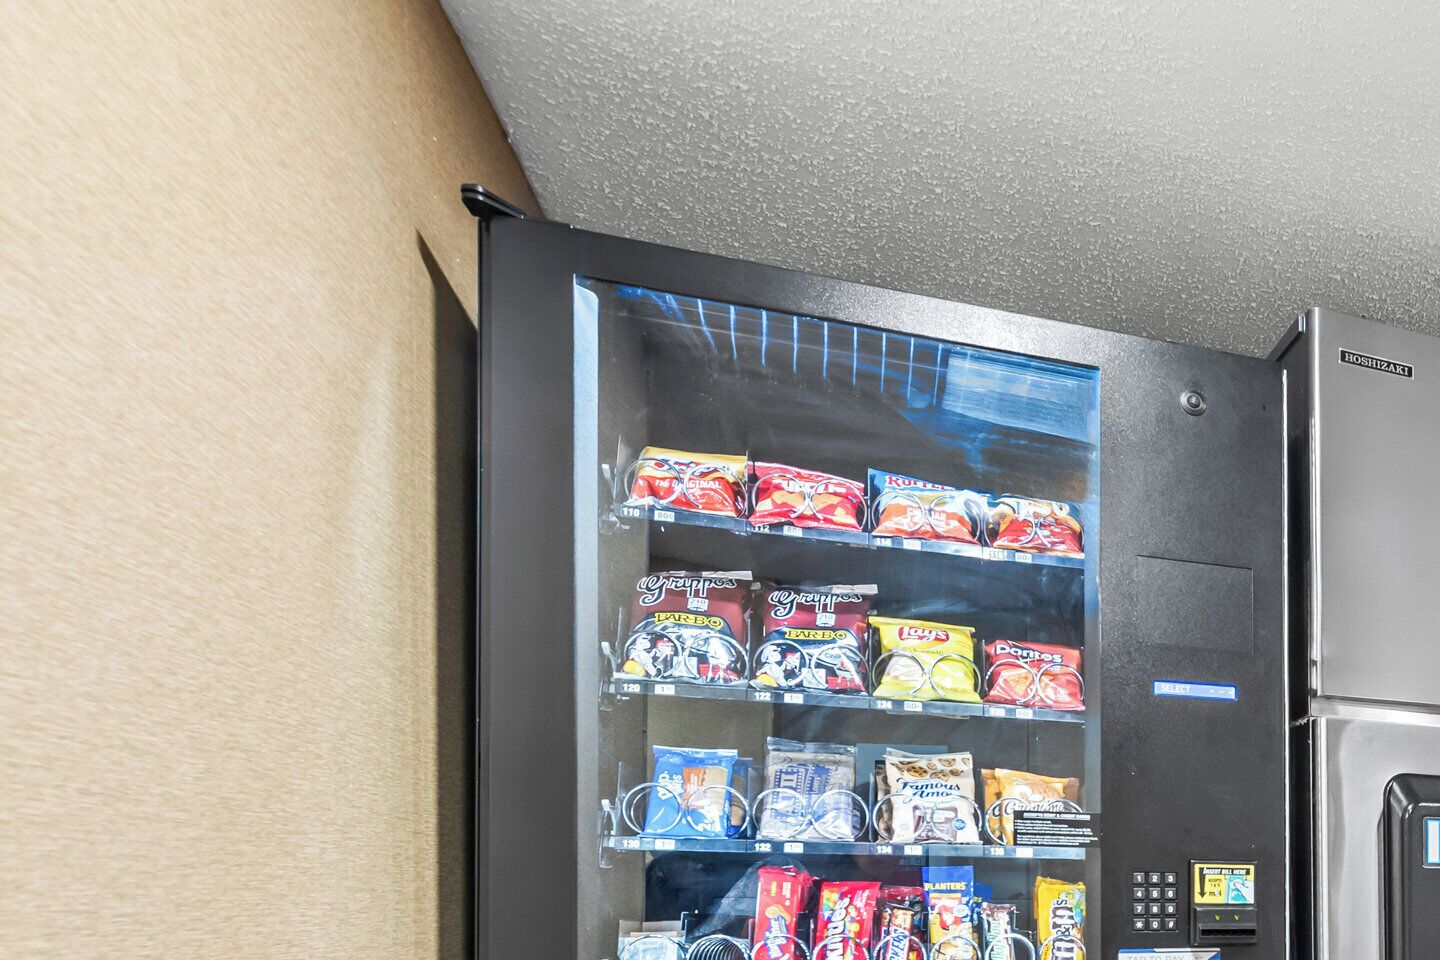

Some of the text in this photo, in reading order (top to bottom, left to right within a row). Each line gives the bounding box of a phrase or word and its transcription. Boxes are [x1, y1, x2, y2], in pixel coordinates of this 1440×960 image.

[1344, 352, 1409, 376] HOSHIZAKI
[623, 507, 640, 517] 110
[996, 644, 1064, 663] Doritos
[622, 683, 640, 692] 120
[1160, 683, 1190, 693] SELECT
[754, 692, 771, 700] 122
[876, 700, 892, 709] 124
[896, 778, 960, 790] Famous
[903, 790, 953, 803] Amo
[623, 840, 640, 848] 130
[754, 843, 771, 851] 132
[876, 845, 892, 854] 134
[923, 882, 967, 891] PLANTERS
